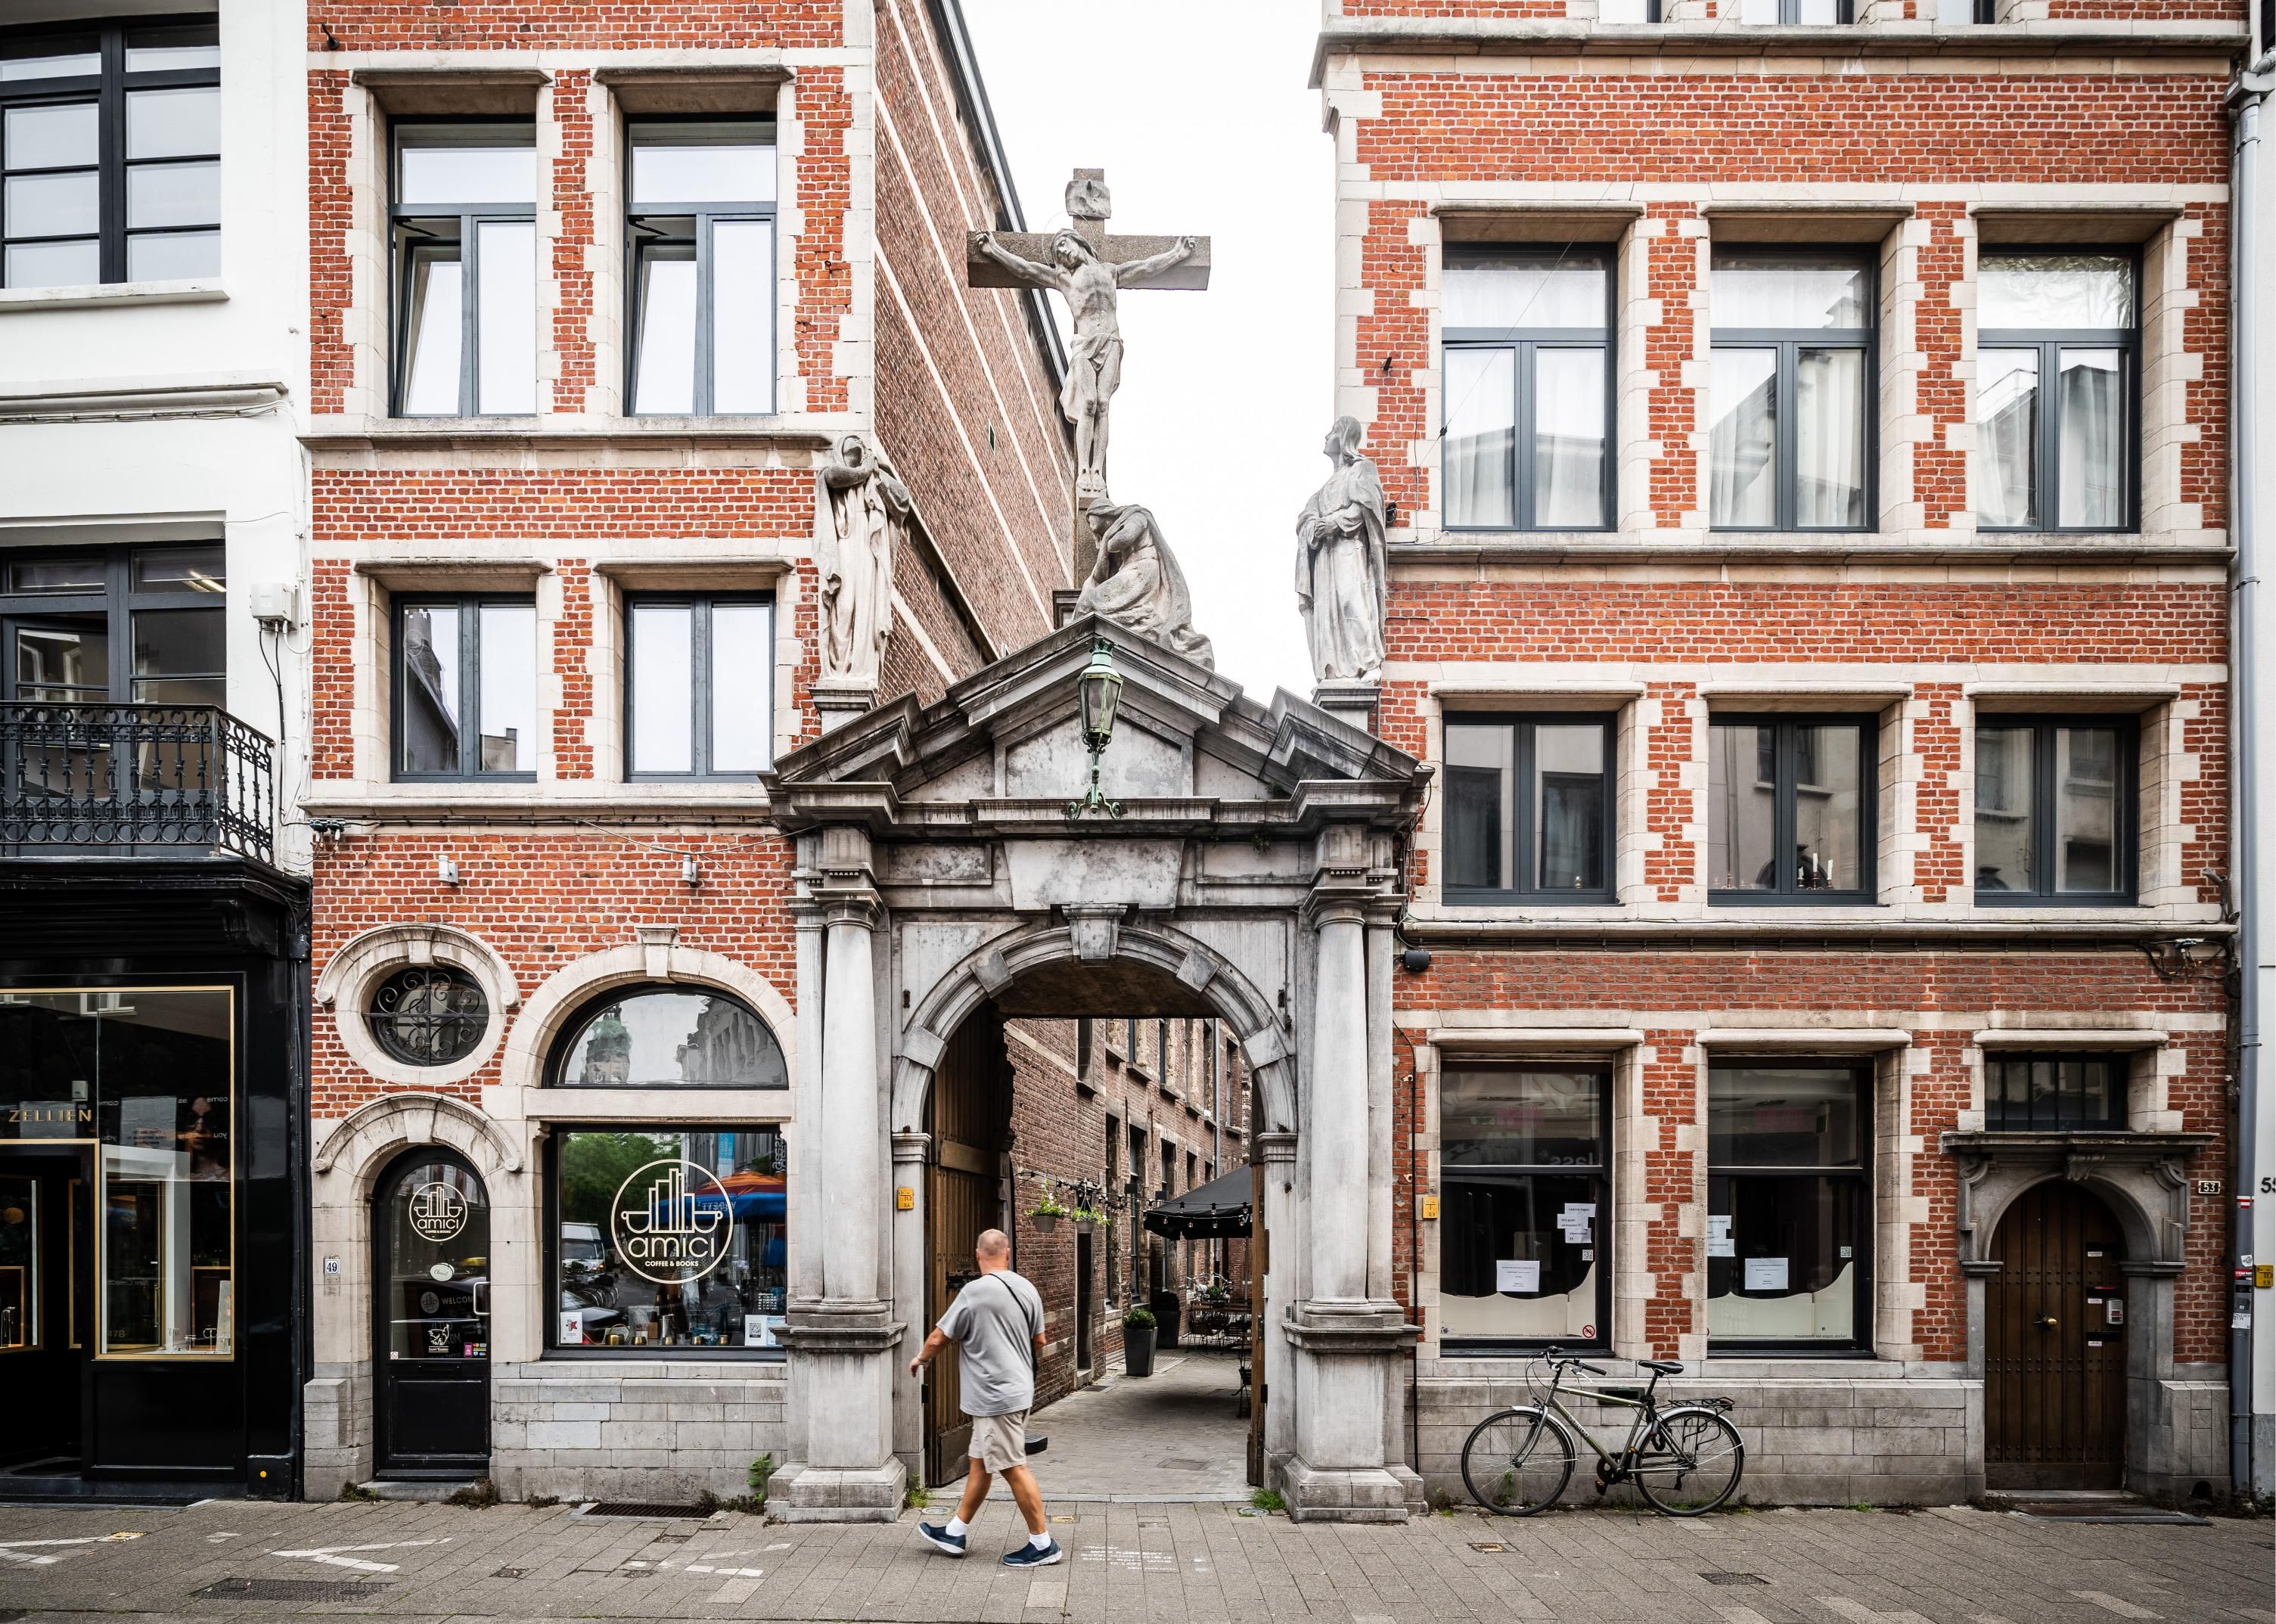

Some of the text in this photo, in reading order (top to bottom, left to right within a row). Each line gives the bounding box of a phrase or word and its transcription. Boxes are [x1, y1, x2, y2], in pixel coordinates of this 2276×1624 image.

[8, 1109, 92, 1123] ZELLIEN
[2203, 1182, 2215, 1192] 53
[417, 1219, 459, 1229] amici
[628, 1237, 715, 1258] amici
[326, 1262, 337, 1272] 49
[441, 1295, 474, 1305] WELCOM
